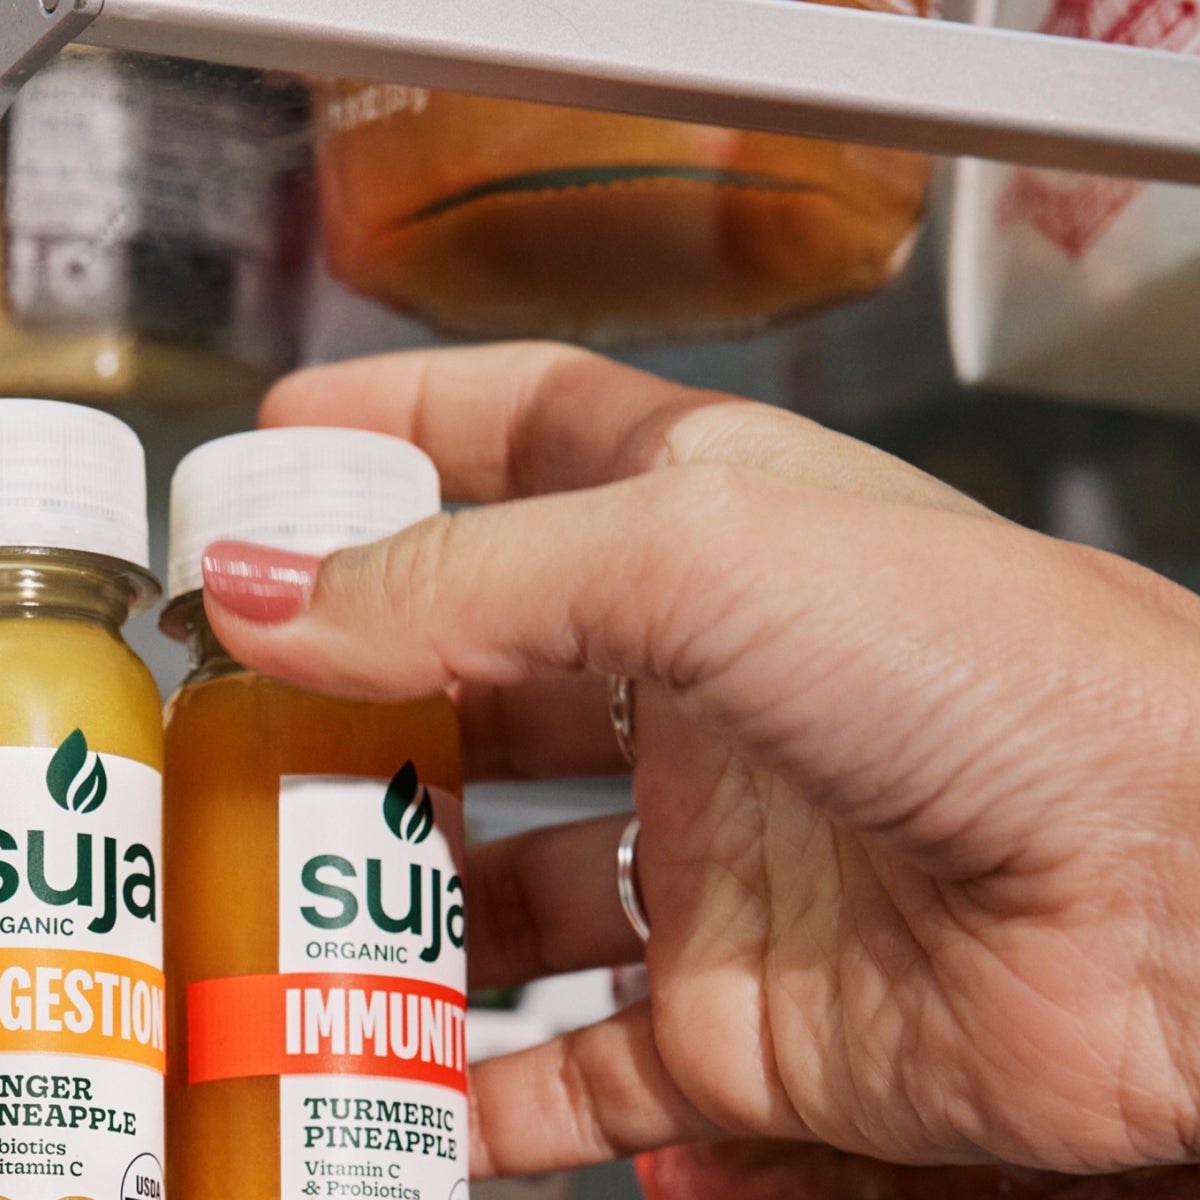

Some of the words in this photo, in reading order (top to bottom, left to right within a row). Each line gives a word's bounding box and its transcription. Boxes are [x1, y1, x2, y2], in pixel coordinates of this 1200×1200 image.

[306, 941, 408, 964] ORGANIC
[285, 988, 466, 1072] IMMUNIT
[303, 1097, 454, 1132] TURMERIC
[304, 1126, 457, 1161] PINEAPPLE
[70, 1161, 83, 1177] C
[304, 1160, 383, 1178] Vitamin
[388, 1163, 401, 1178] C
[136, 1174, 161, 1200] USDA
[304, 1180, 321, 1196] &
[326, 1181, 421, 1200] Probiotics
